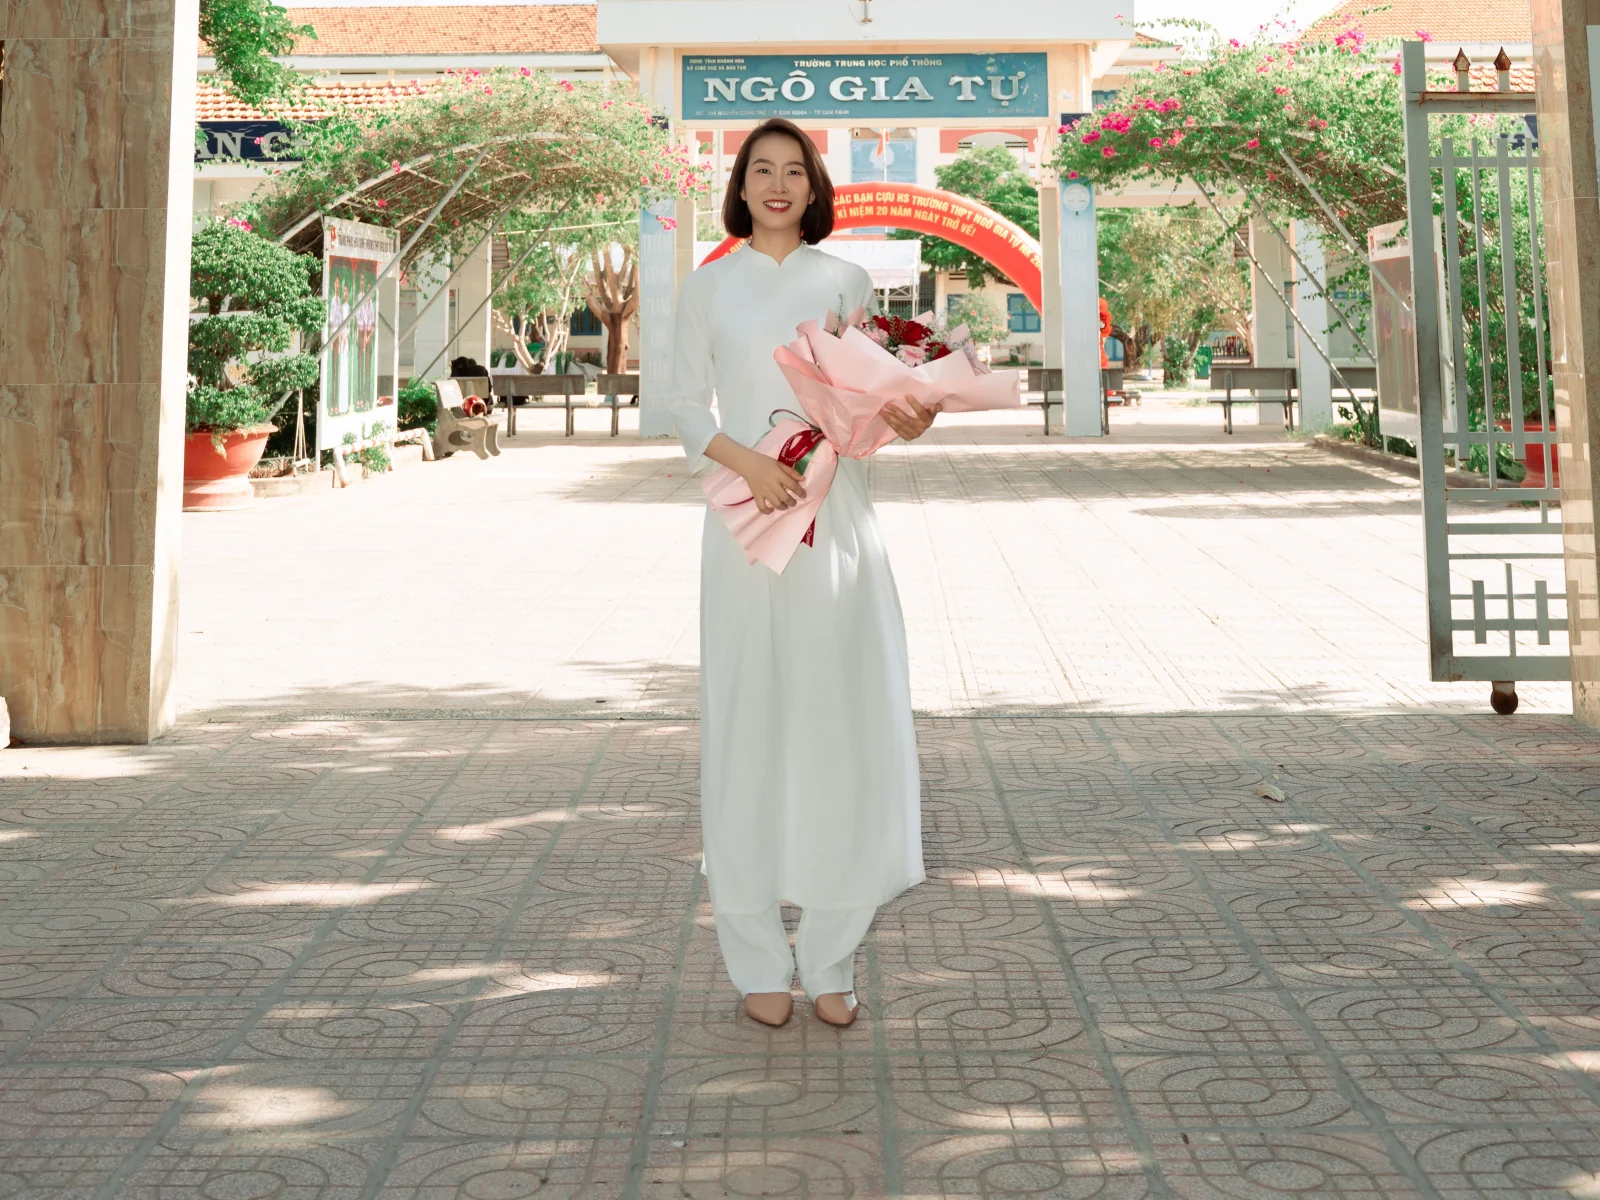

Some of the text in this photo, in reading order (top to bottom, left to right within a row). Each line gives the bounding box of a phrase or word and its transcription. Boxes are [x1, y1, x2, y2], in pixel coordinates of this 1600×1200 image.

[794, 56, 943, 68] TRƯỜNG TRUNG HỌC PHỔ THÔNG
[703, 69, 1026, 107] NGÔ GIA TỰ
[849, 204, 874, 218] NIỆM
[876, 206, 888, 216] 20
[890, 205, 912, 217] NĂM
[853, 192, 873, 204] BẠN
[876, 192, 895, 204] CỰU
[897, 193, 910, 203] HS
[912, 195, 949, 212] TRƯỜNG
[950, 204, 973, 220] THPT
[972, 213, 994, 230] NGÔ
[993, 224, 1009, 240] GIA
